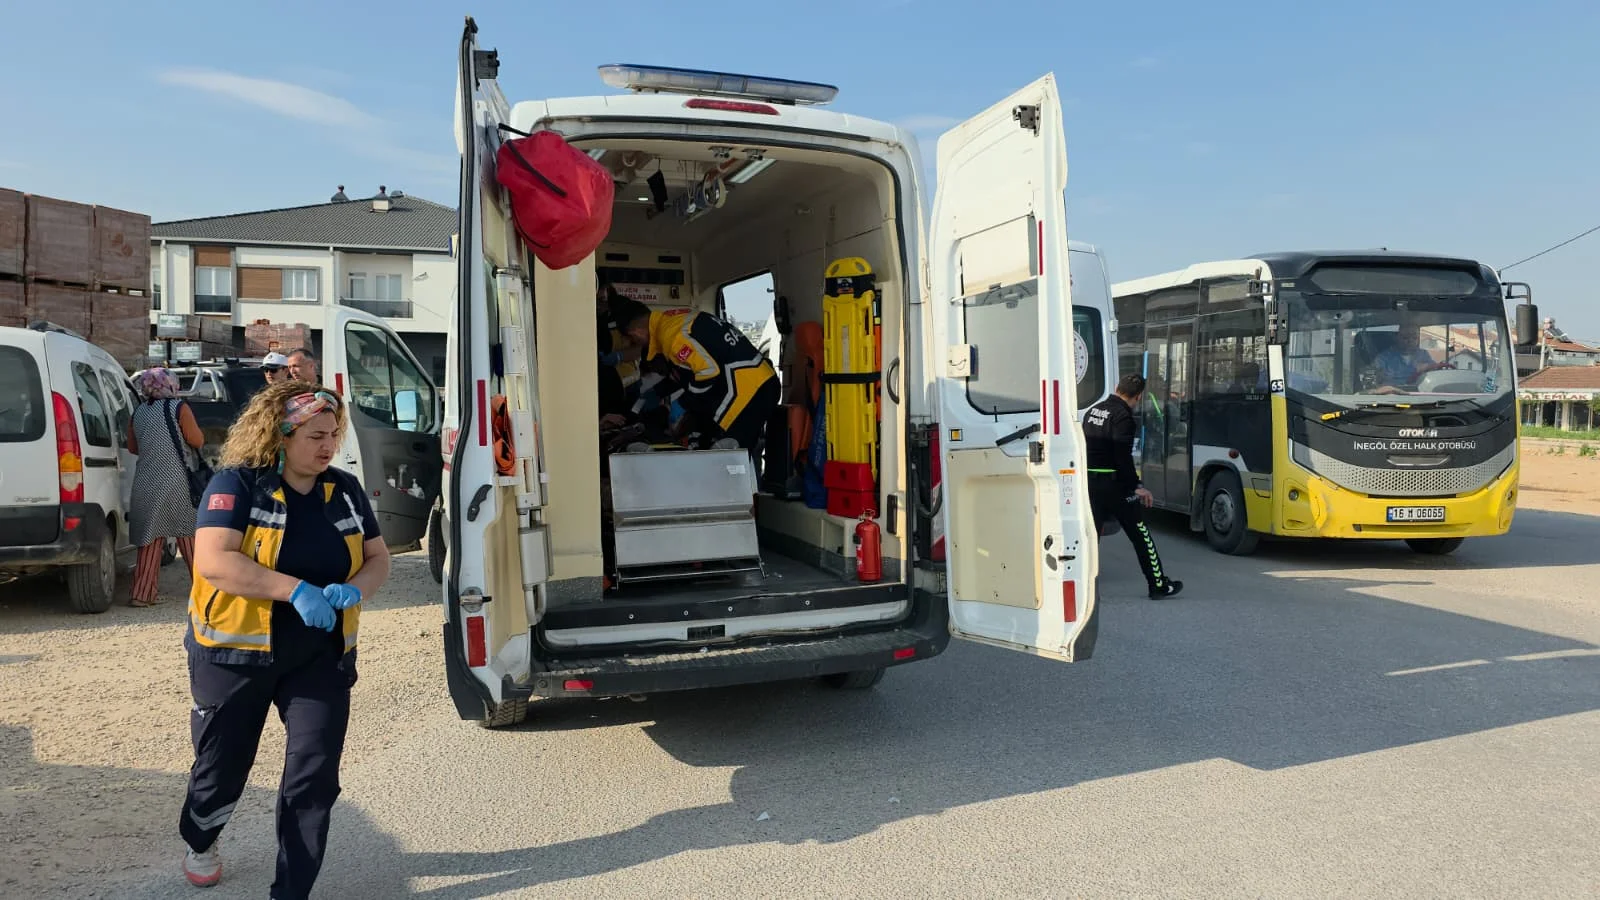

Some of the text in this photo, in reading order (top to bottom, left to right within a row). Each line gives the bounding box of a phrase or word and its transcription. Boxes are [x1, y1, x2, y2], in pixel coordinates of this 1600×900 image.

[1271, 380, 1284, 392] 65
[1399, 428, 1438, 438] OTOKAR
[1353, 440, 1476, 450] İNEGÖL ÖZEL HALK OTOBÜSÜ
[1394, 508, 1404, 518] 16
[1416, 508, 1443, 518] 06065
